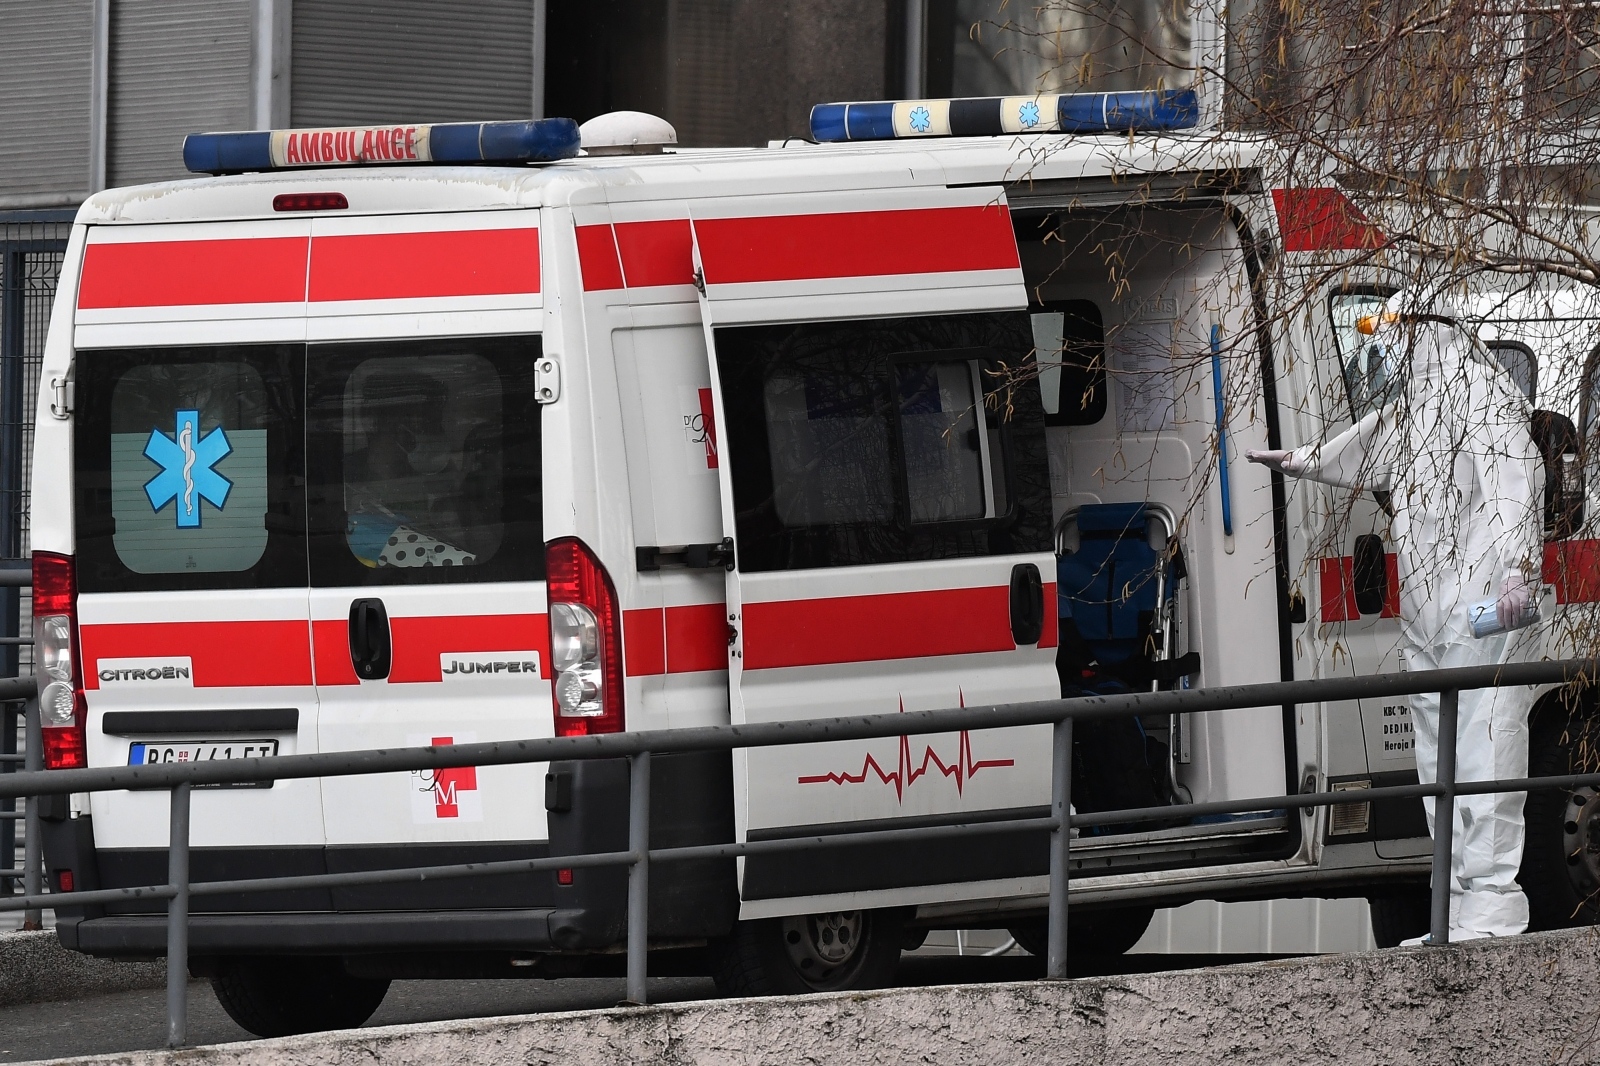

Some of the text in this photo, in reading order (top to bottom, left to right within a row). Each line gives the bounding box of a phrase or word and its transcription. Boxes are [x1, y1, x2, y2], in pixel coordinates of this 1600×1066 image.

[287, 126, 417, 163] AMBULANCE
[98, 666, 190, 682] CITROËN
[442, 660, 537, 674] JUMPER
[1383, 706, 1396, 717] KBC
[1383, 722, 1416, 735] DEDINJ
[1384, 738, 1409, 752] Heroja
